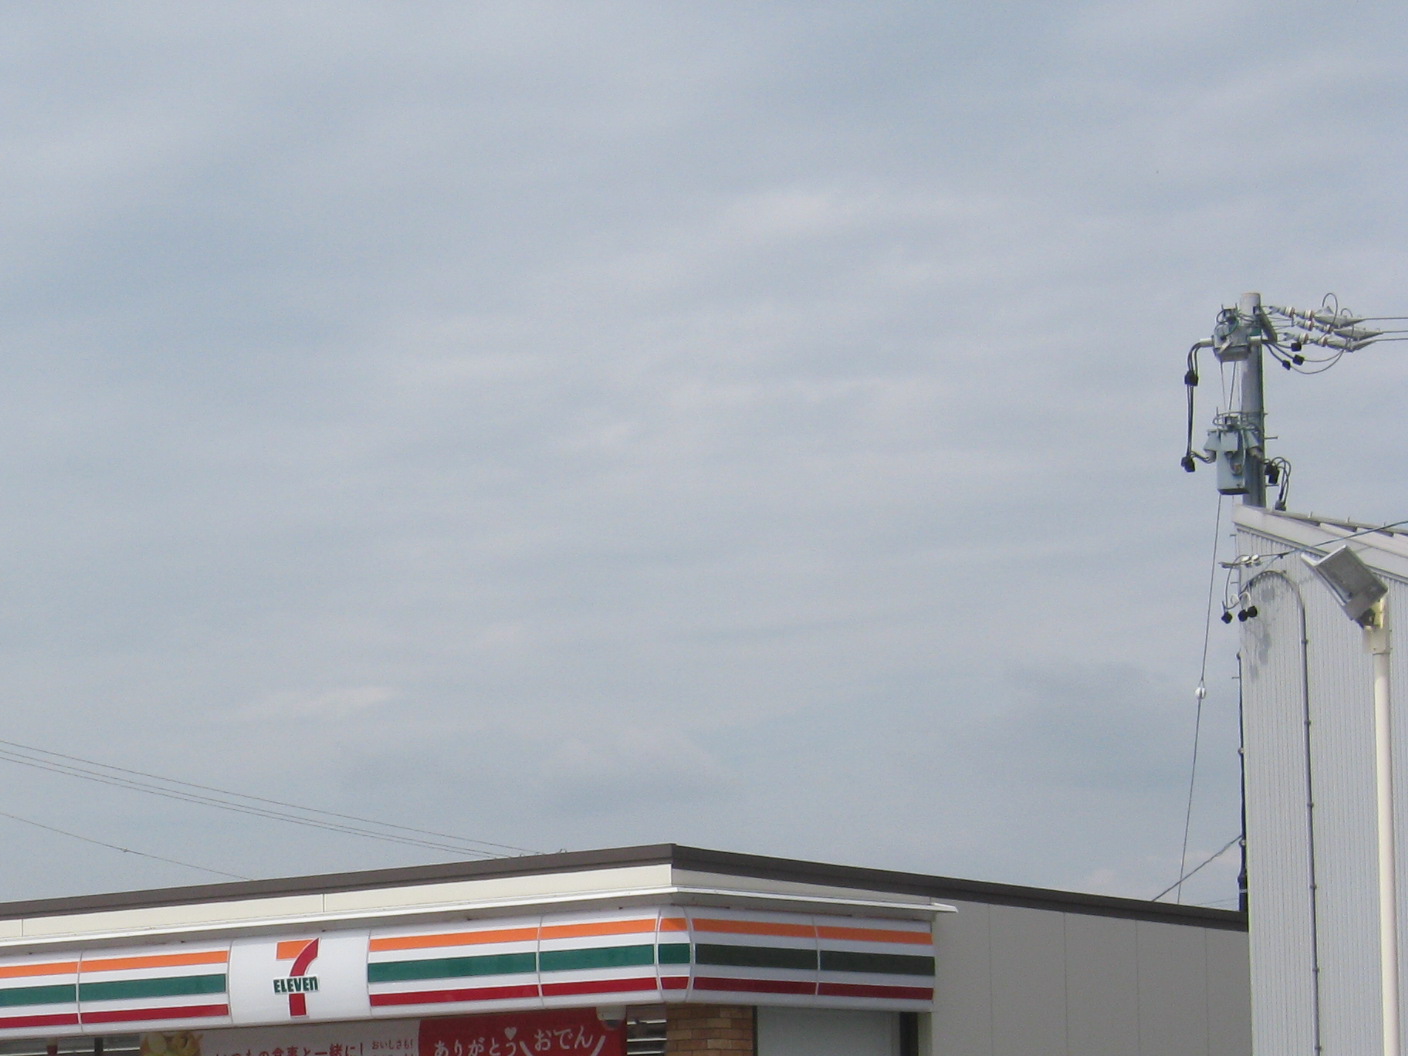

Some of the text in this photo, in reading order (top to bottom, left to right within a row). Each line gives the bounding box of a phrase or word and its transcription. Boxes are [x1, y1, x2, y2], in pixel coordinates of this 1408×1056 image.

[276, 937, 320, 1017] 7
[533, 1025, 594, 1052] おでん
